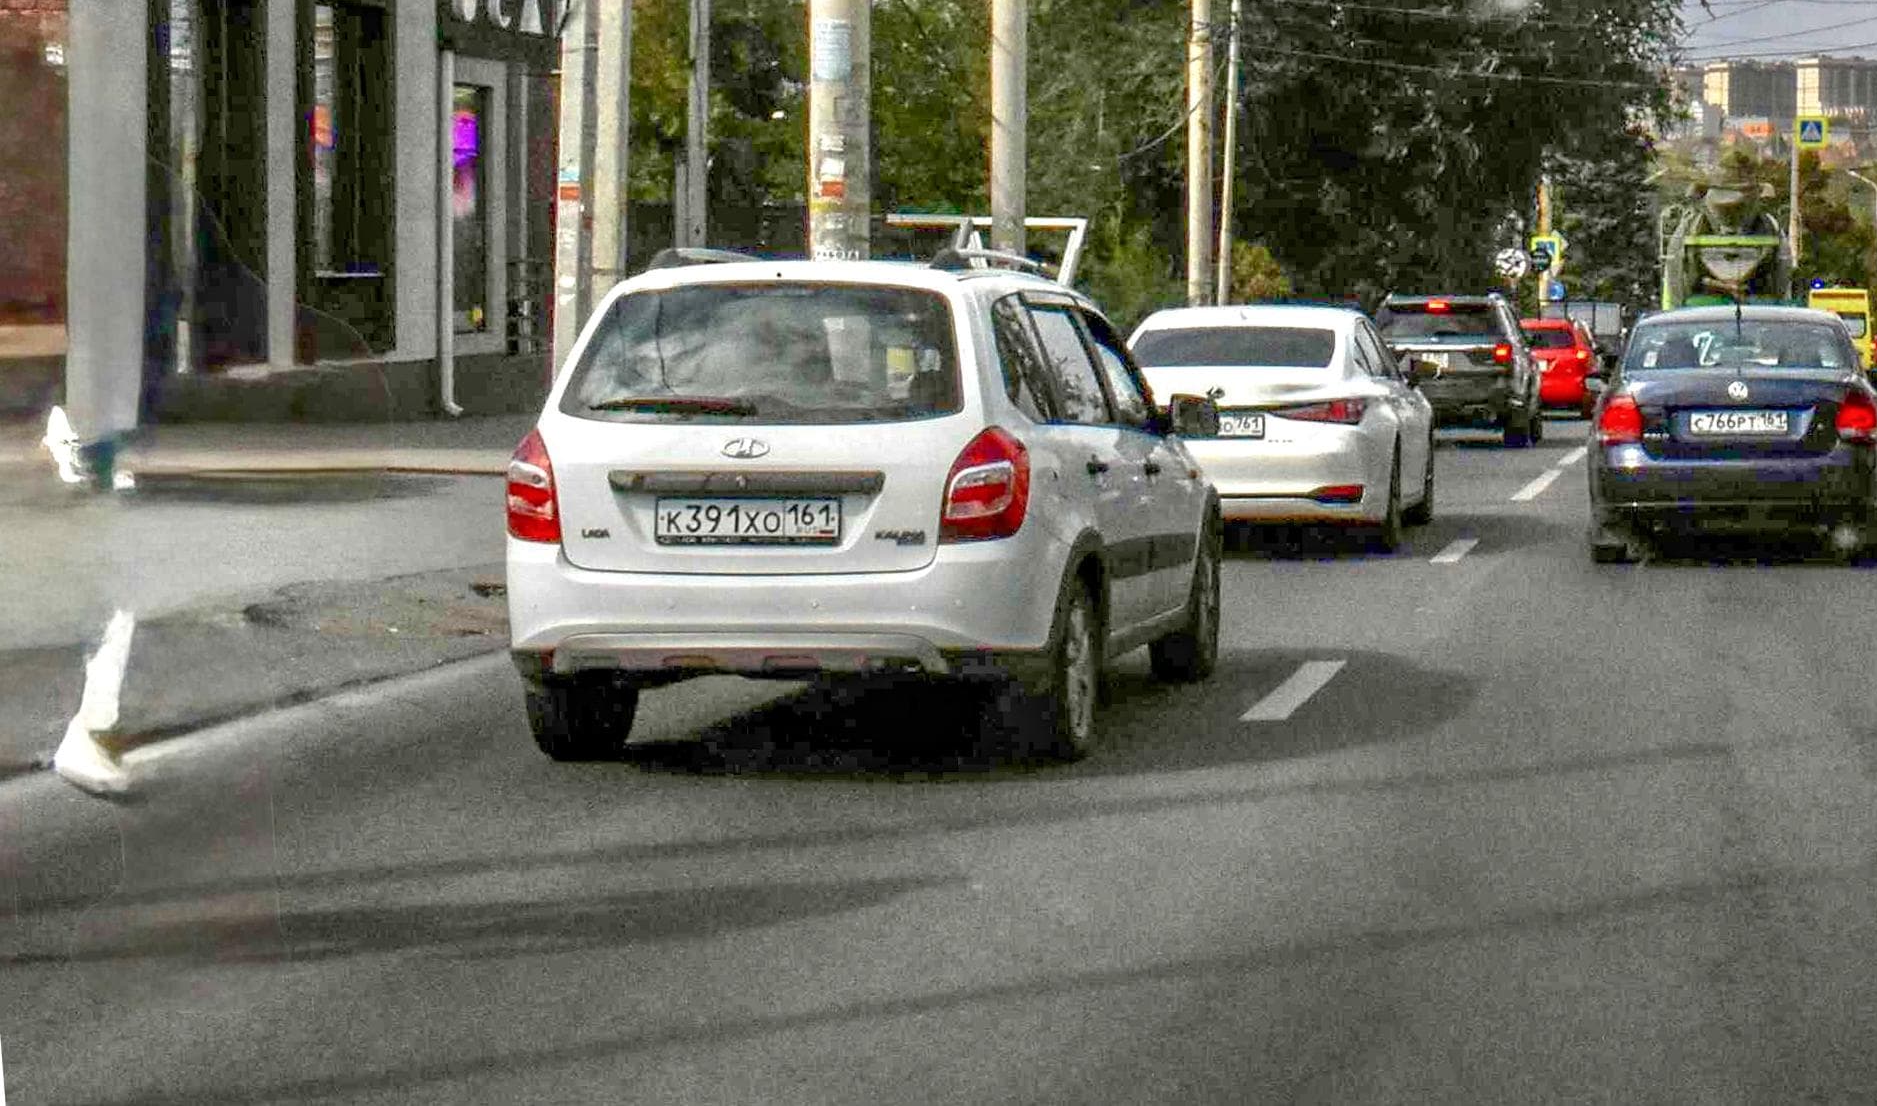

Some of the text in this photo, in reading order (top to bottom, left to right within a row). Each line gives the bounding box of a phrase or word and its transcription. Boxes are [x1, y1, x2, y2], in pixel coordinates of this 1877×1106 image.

[1694, 414, 1755, 429] С766РТ
[666, 503, 830, 533] К391ХО 161
